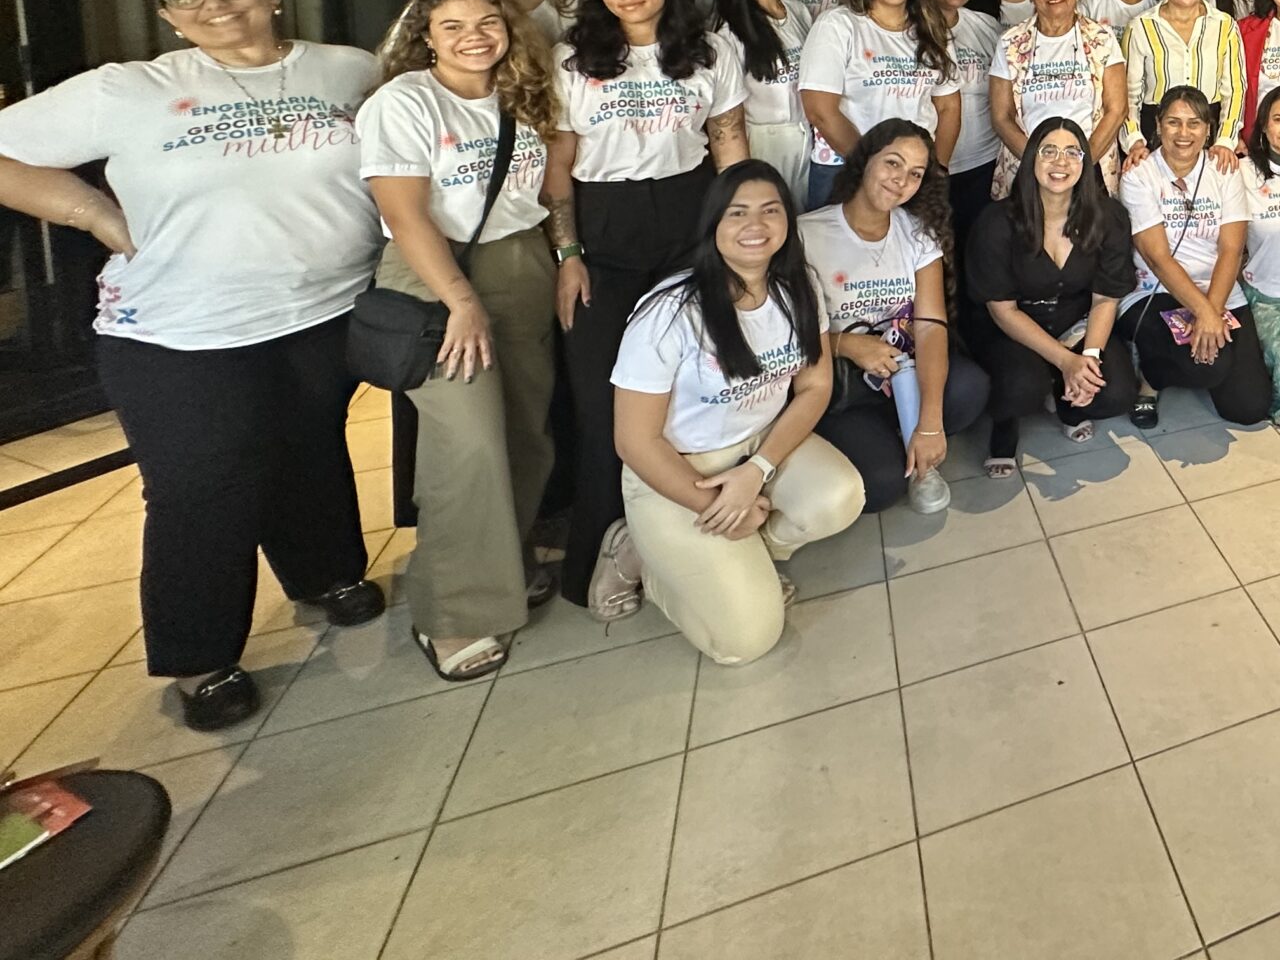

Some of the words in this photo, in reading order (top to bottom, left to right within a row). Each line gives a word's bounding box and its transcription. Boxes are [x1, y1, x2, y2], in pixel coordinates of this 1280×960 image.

[884, 77, 917, 86] COISAS
[1028, 81, 1066, 92] COISAS
[1075, 79, 1087, 87] DE
[600, 96, 686, 111] GEOCIÊNCIAS
[589, 110, 613, 126] SÃO
[616, 108, 662, 118] COISAS
[675, 104, 690, 114] DE
[163, 135, 206, 152] SÃO
[312, 118, 337, 129] DE
[441, 173, 474, 187] SÃO
[1260, 211, 1276, 220] SÃO
[1207, 219, 1217, 227] DE
[840, 295, 912, 312] GEOCIÊNCIAS
[852, 306, 891, 318] COISAS
[700, 395, 731, 406] SÃO
